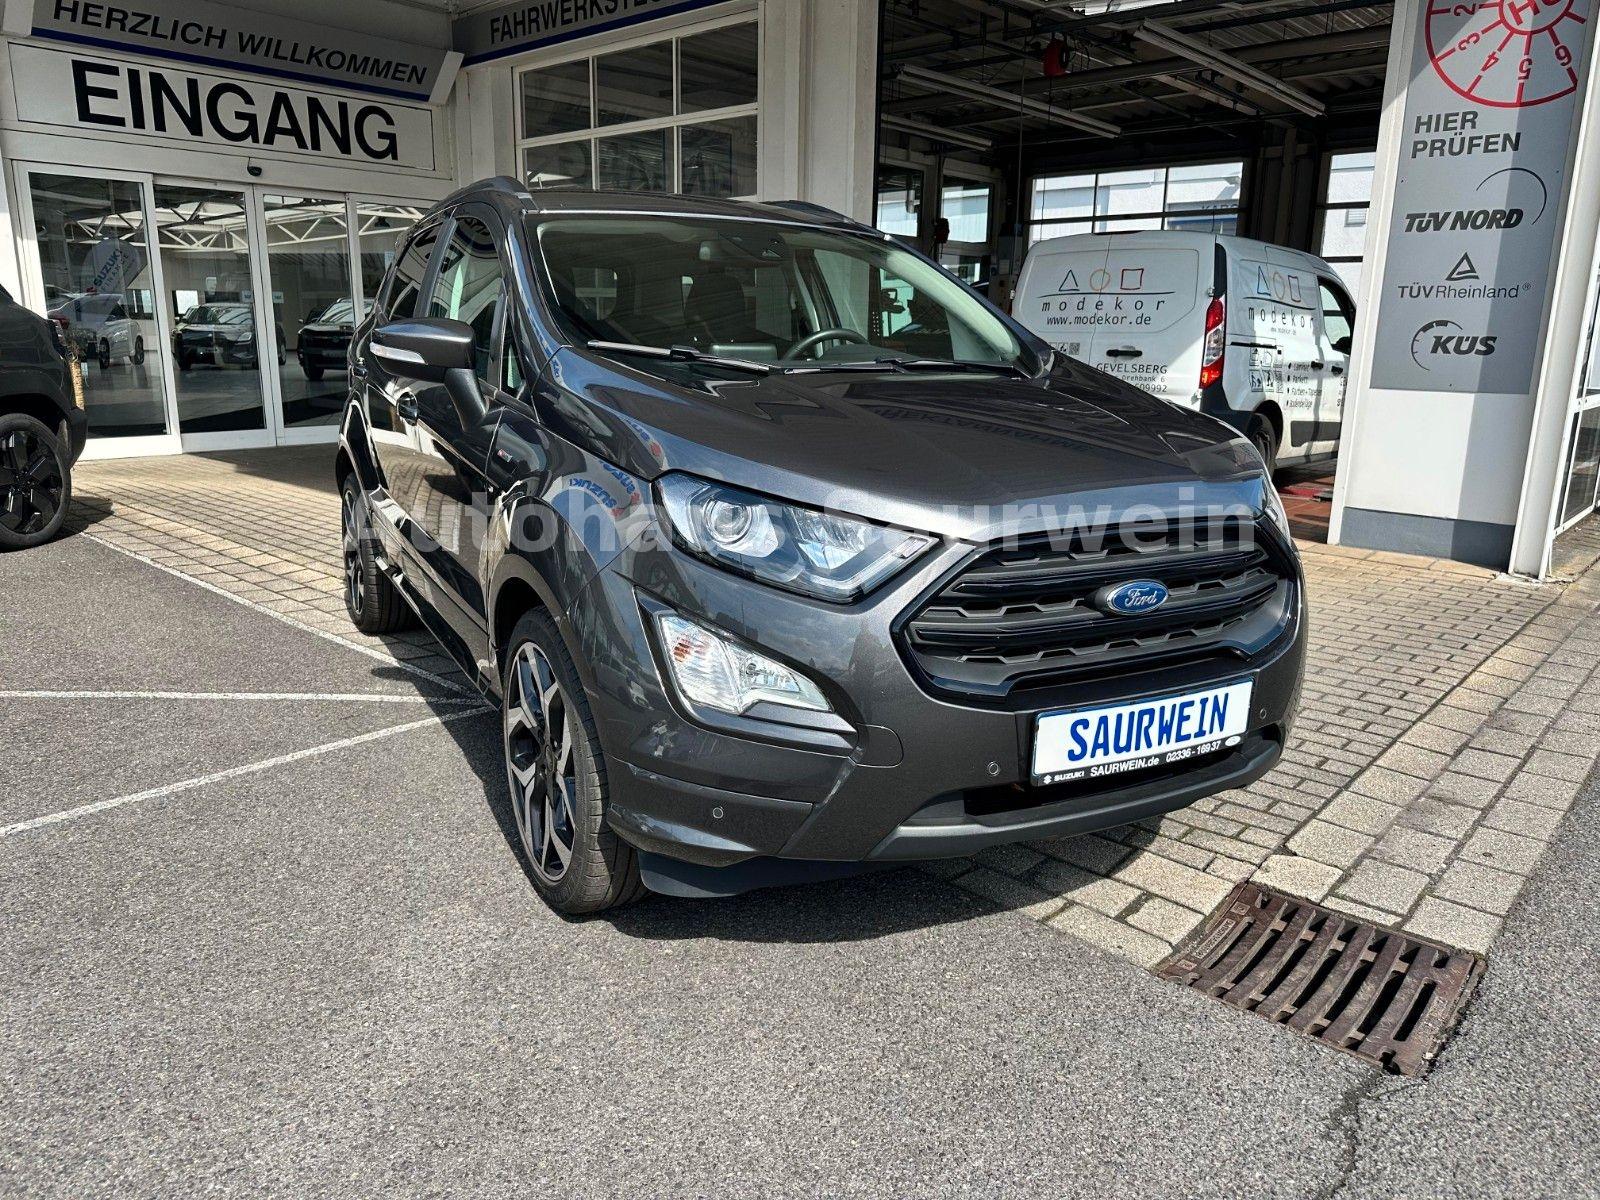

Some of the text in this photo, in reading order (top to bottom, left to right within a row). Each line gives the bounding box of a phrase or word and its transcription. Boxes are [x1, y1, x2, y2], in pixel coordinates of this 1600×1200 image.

[53, 0, 427, 84] HERZLICH WILLKOMMEN
[1458, 32, 1480, 51] 3
[1481, 51, 1499, 72] 4
[1517, 58, 1532, 80] 5
[71, 60, 399, 161] EINGANG
[1414, 110, 1479, 134] HIER
[1411, 132, 1521, 159] PRÜFEN
[1449, 208, 1524, 231] NORD
[93, 248, 123, 287] SUZUKI
[1398, 282, 1519, 299] TÜV Rheinland
[1041, 297, 1165, 311] modekor
[1046, 313, 1152, 326] www.modekor.de
[1430, 335, 1498, 356] KÜS
[1096, 362, 1168, 374] GEVELSBERG
[1124, 587, 1158, 607] Ford
[1068, 692, 1229, 762] SAURWEIN
[1054, 771, 1085, 782] SUZUKI
[1090, 756, 1160, 777] SAURWEIN.de
